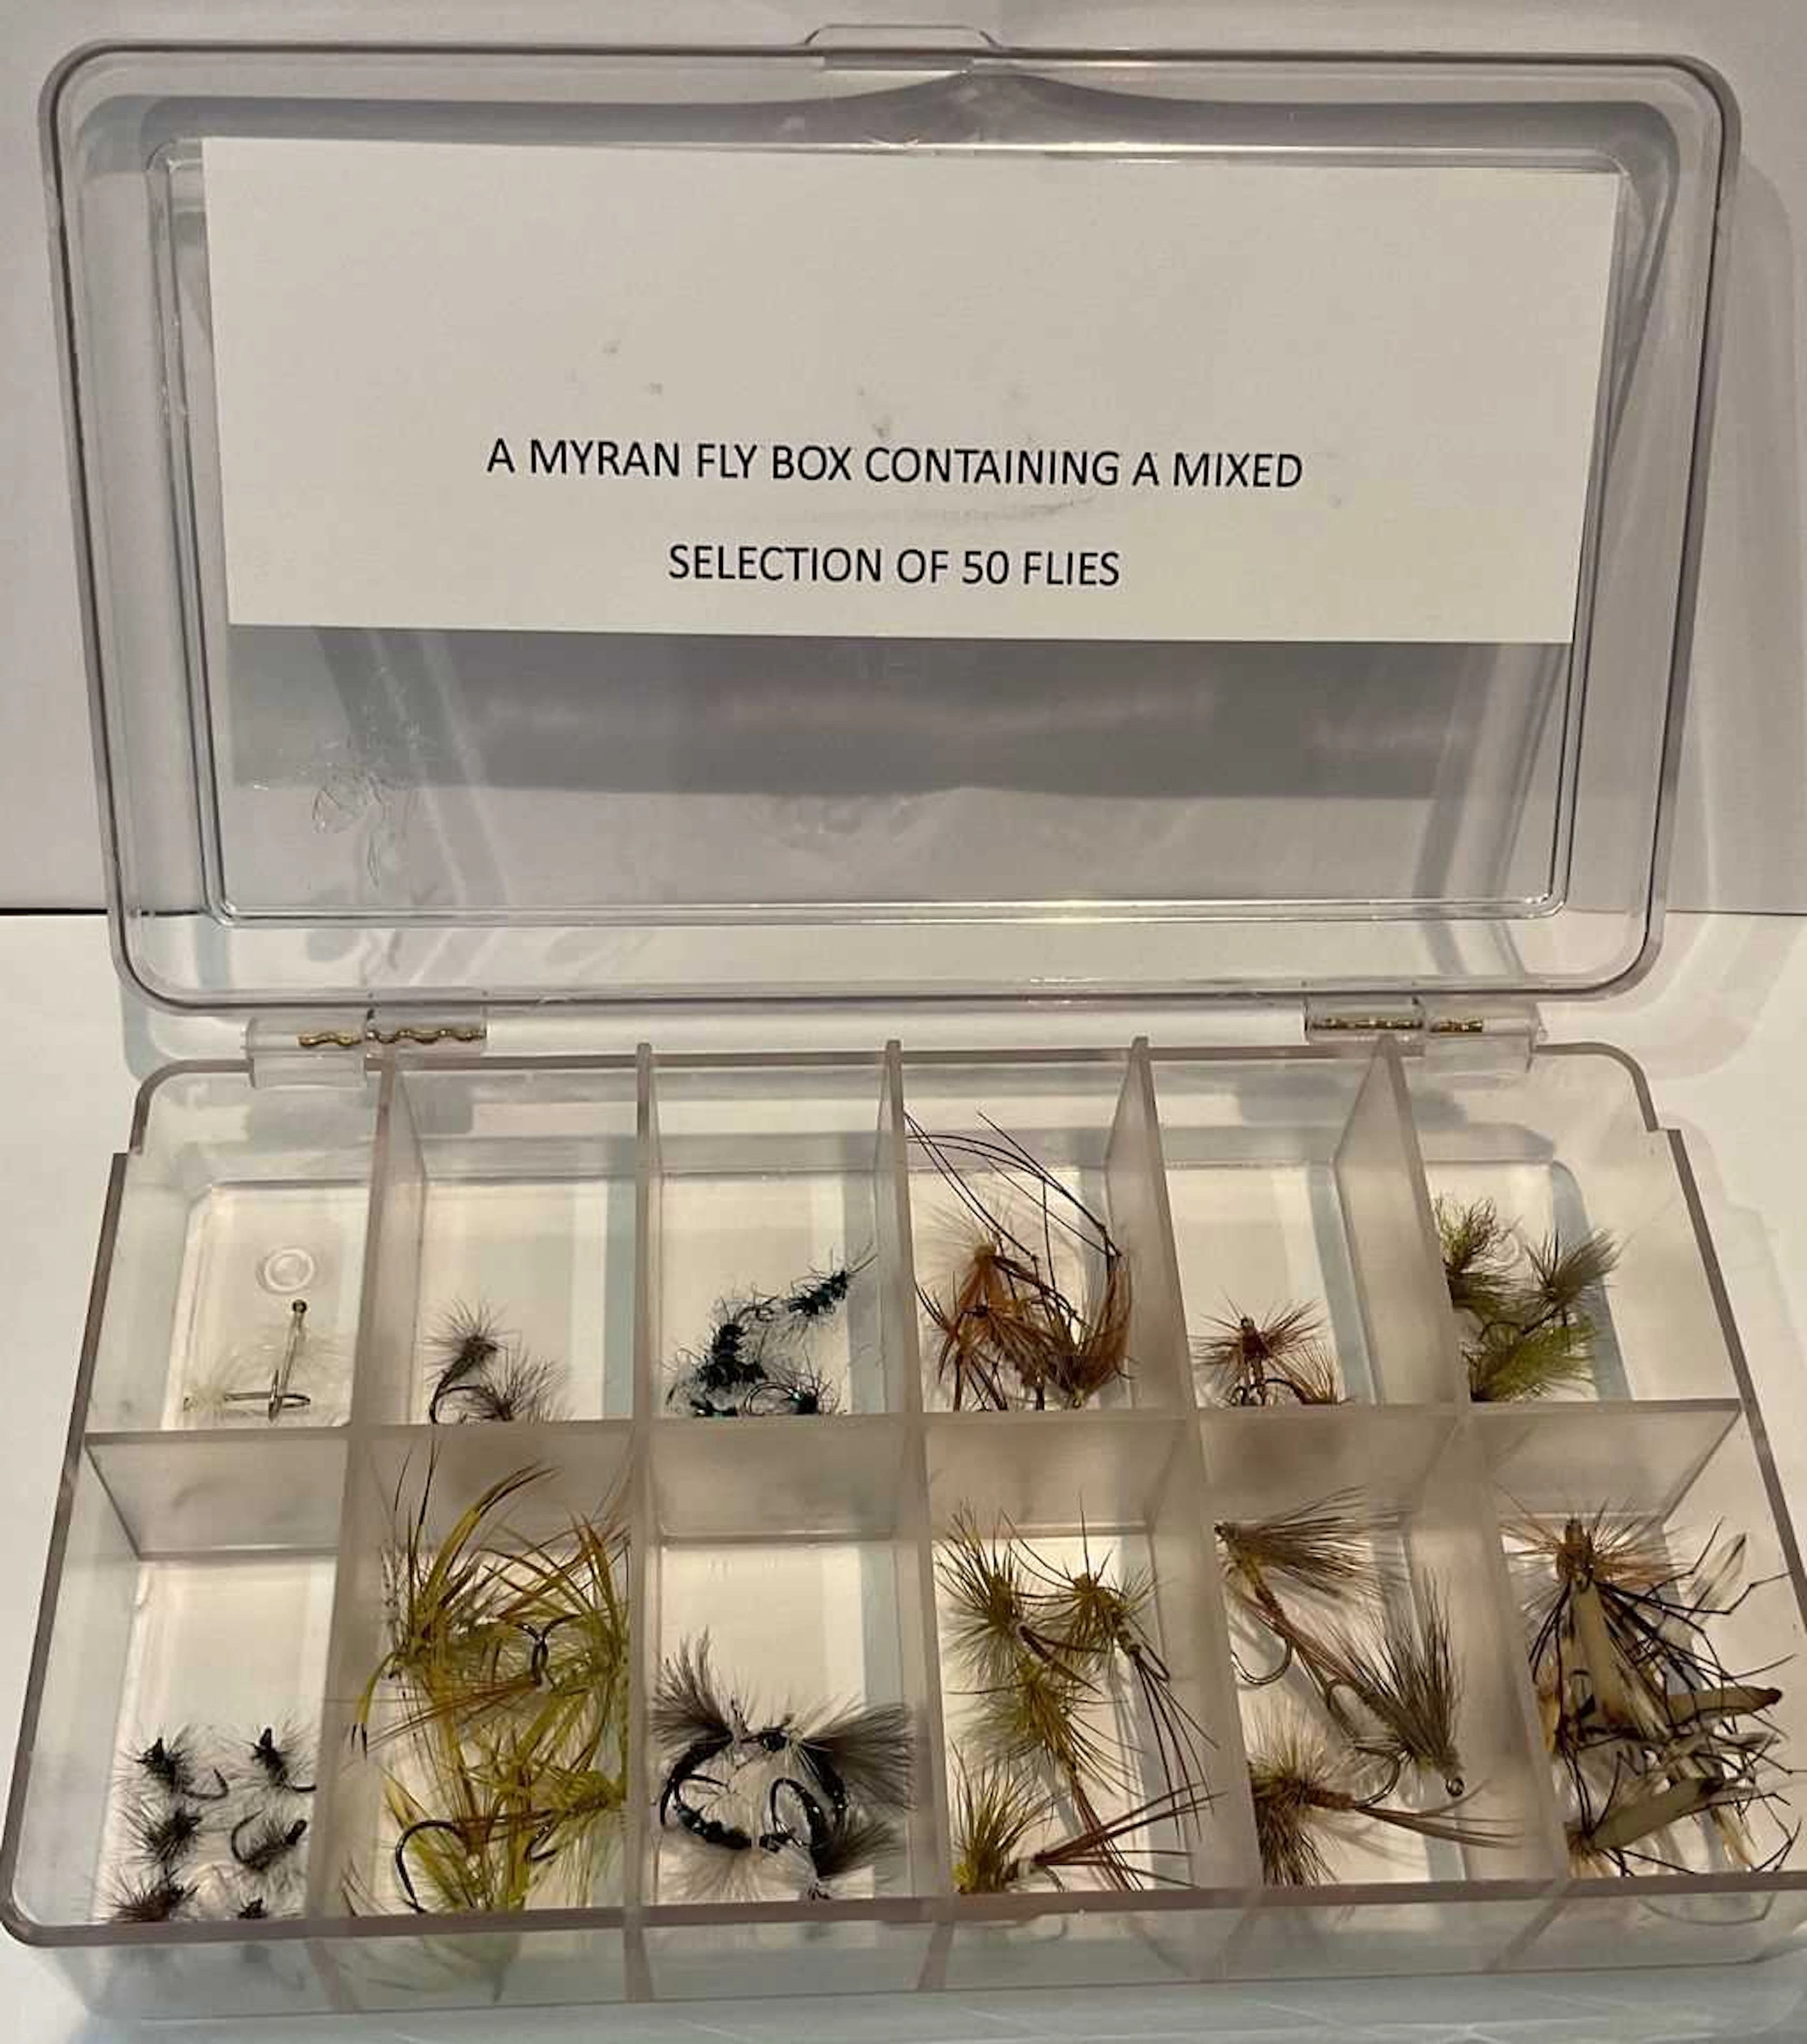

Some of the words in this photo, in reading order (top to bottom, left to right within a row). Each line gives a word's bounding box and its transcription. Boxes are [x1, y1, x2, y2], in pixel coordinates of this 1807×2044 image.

[487, 438, 515, 473] A
[531, 439, 680, 477] MYRAN
[697, 443, 758, 479] FLY
[773, 445, 852, 481] BOX
[865, 447, 1119, 486] CONTAINING
[1132, 451, 1159, 487] A
[1174, 452, 1303, 488] MIXED
[669, 544, 881, 583] SELECTION
[896, 549, 949, 584] OF
[962, 550, 1009, 585] 50
[1023, 551, 1119, 586] FLIES
